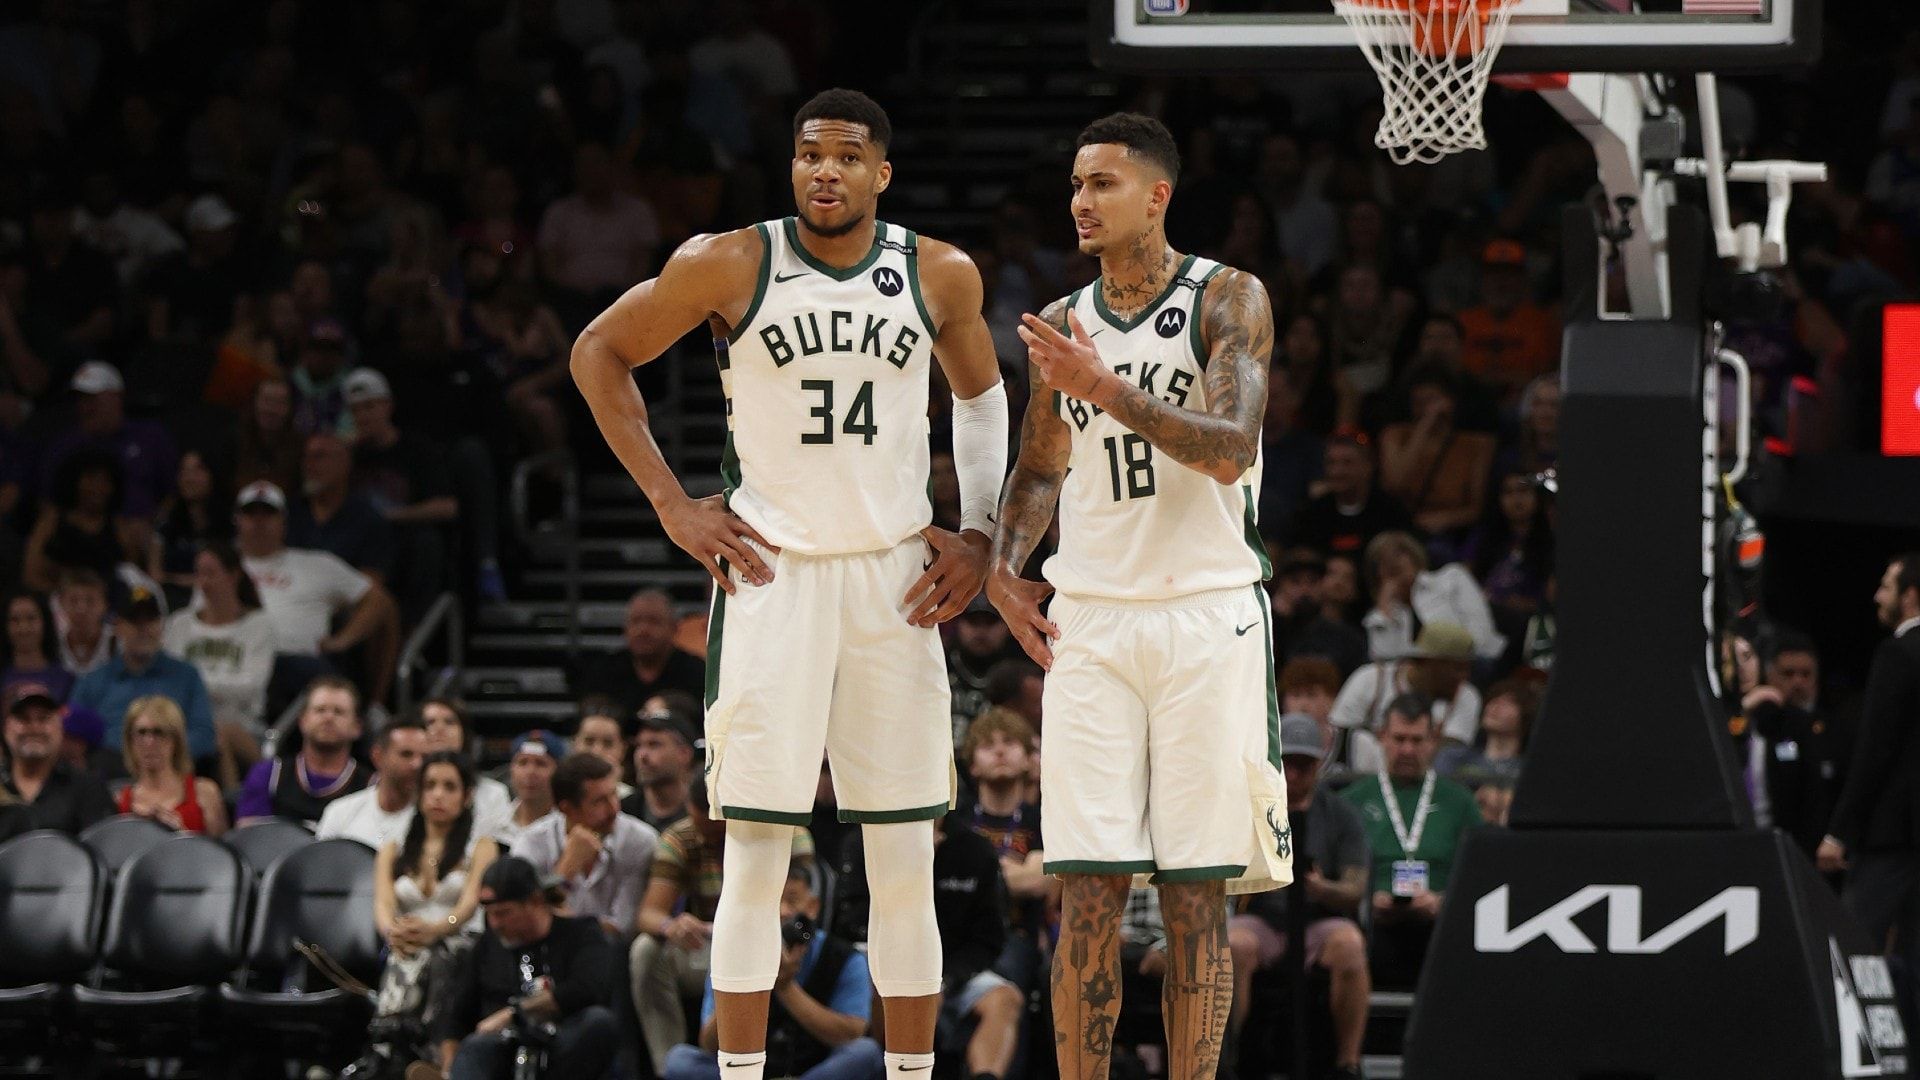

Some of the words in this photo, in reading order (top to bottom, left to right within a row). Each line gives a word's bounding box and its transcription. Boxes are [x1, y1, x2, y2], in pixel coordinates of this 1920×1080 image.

[759, 310, 920, 369] BUCKS
[801, 380, 878, 445] 34
[1066, 361, 1195, 433] BKS
[1103, 433, 1156, 502] 18
